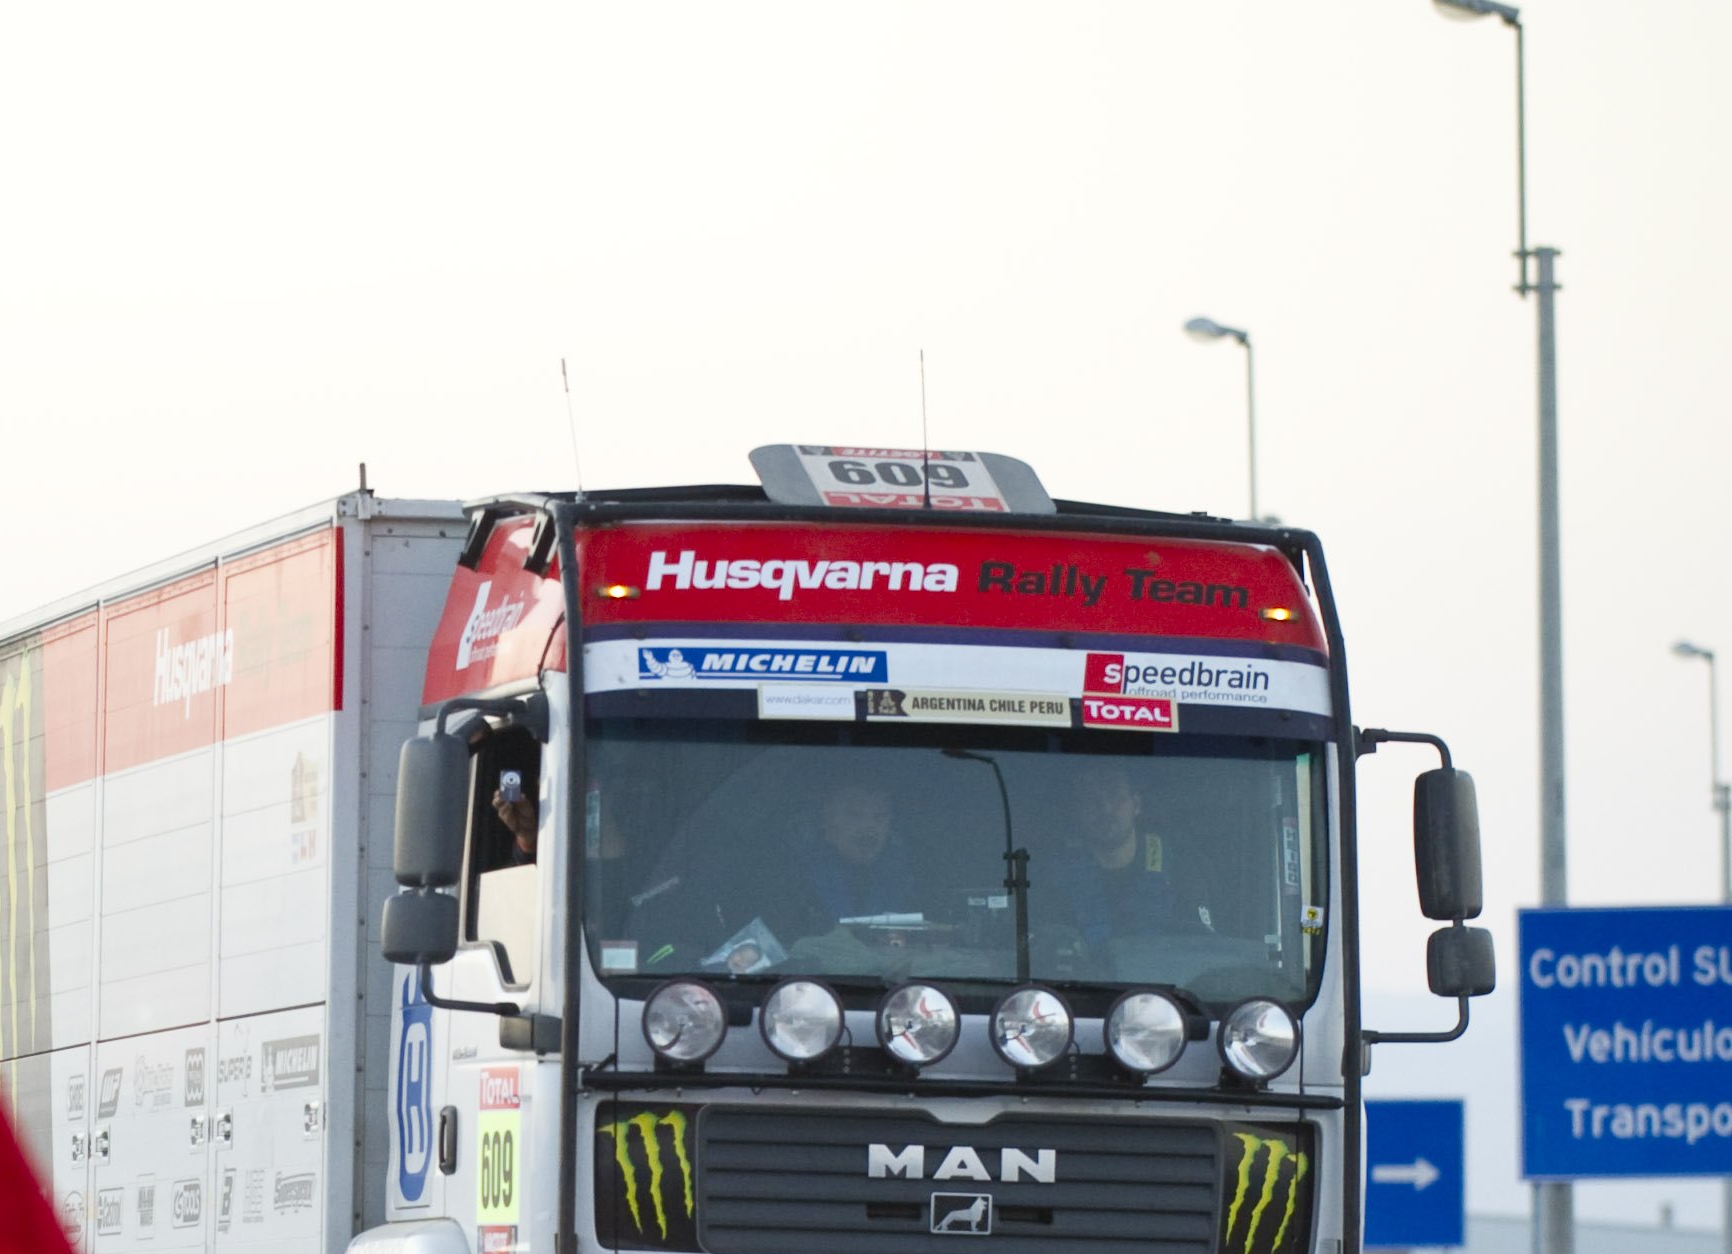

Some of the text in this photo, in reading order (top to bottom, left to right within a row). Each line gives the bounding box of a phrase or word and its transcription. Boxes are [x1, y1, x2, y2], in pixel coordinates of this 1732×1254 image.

[828, 460, 970, 489] 609
[829, 493, 1001, 511] TOTAL
[646, 551, 1250, 608] Husqvarna Rally Team
[154, 627, 234, 720] Husqvarna
[700, 653, 877, 674] MICHELIN
[911, 696, 1064, 715] ARGENTINA CHILE PERU
[1084, 700, 1170, 722] TOTAL
[1181, 689, 1268, 704] performance
[1529, 945, 1679, 987] Control
[275, 1045, 318, 1076] MICHELIN
[481, 1072, 520, 1105] TOTAL
[1565, 1098, 1732, 1145] Transpo
[481, 1129, 514, 1210] 609
[868, 1144, 1057, 1184] MAN
